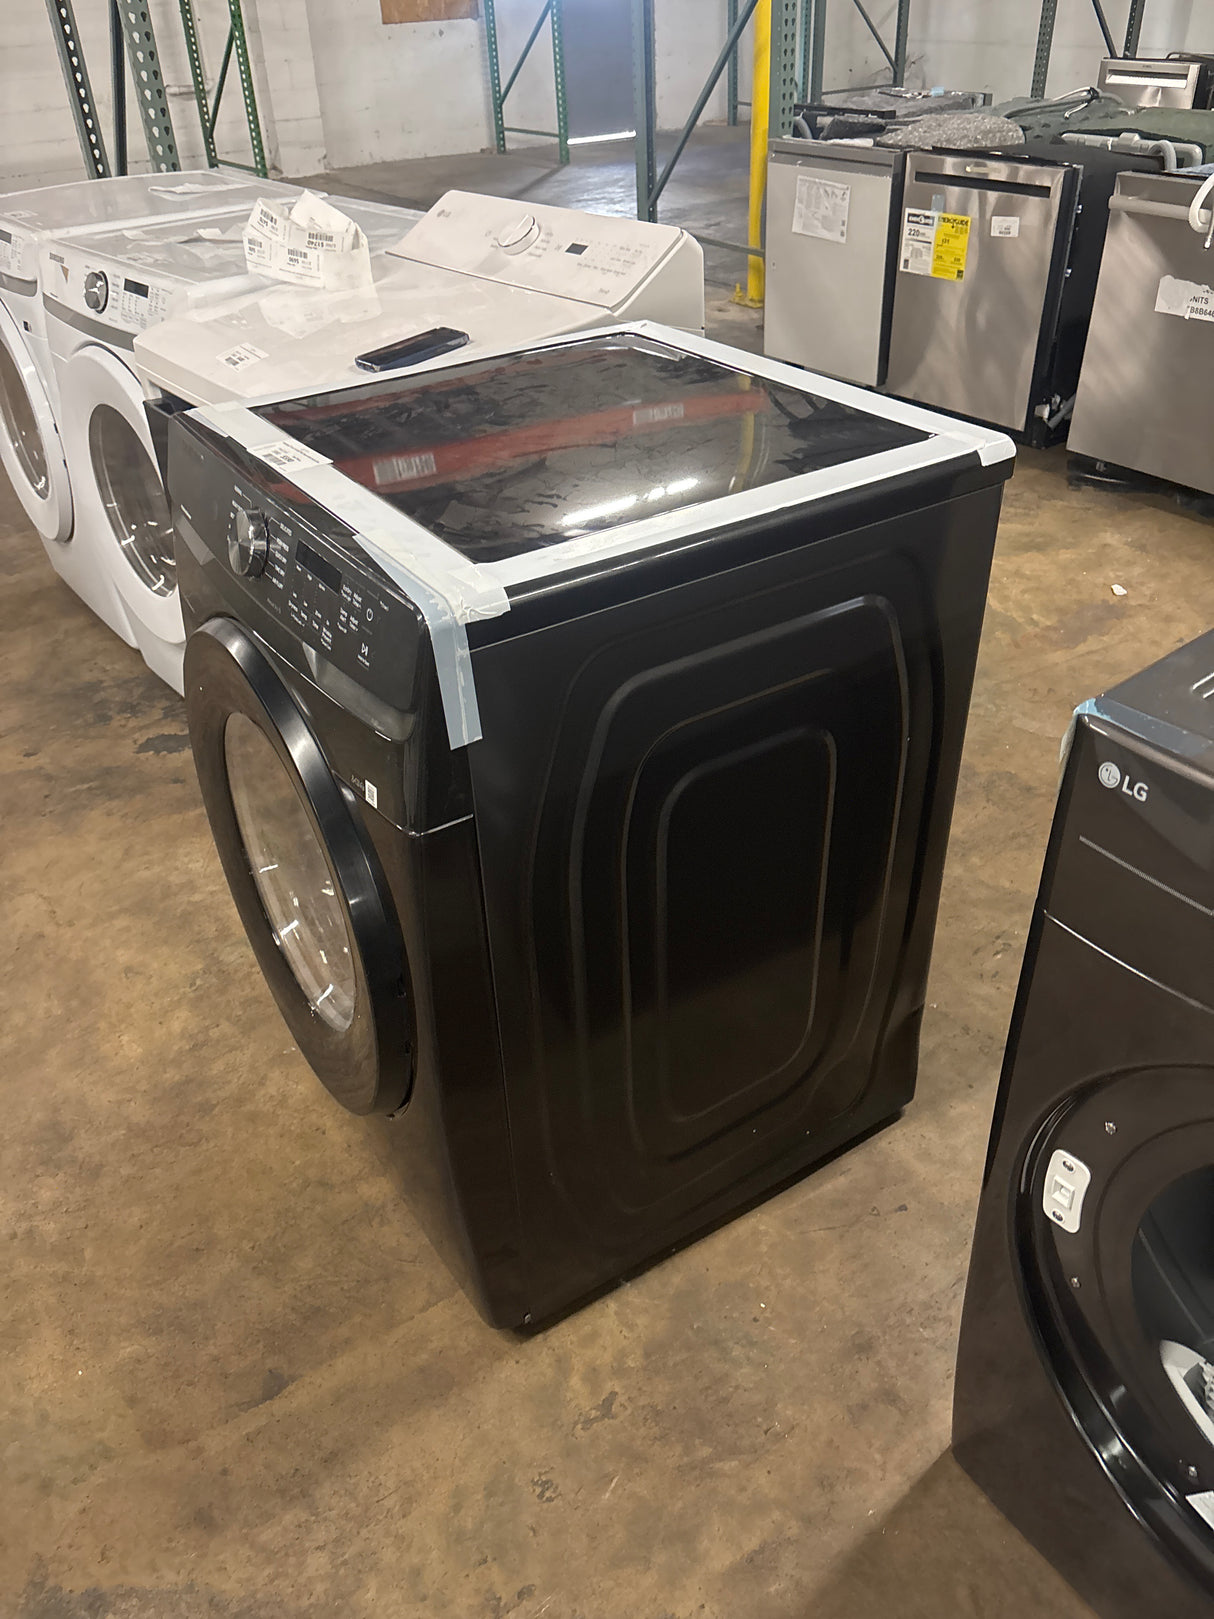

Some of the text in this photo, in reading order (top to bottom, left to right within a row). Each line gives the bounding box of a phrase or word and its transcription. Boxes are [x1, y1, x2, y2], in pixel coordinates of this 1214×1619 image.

[908, 228, 920, 237] 220
[1189, 296, 1209, 305] NITS
[1121, 775, 1149, 802] LG
